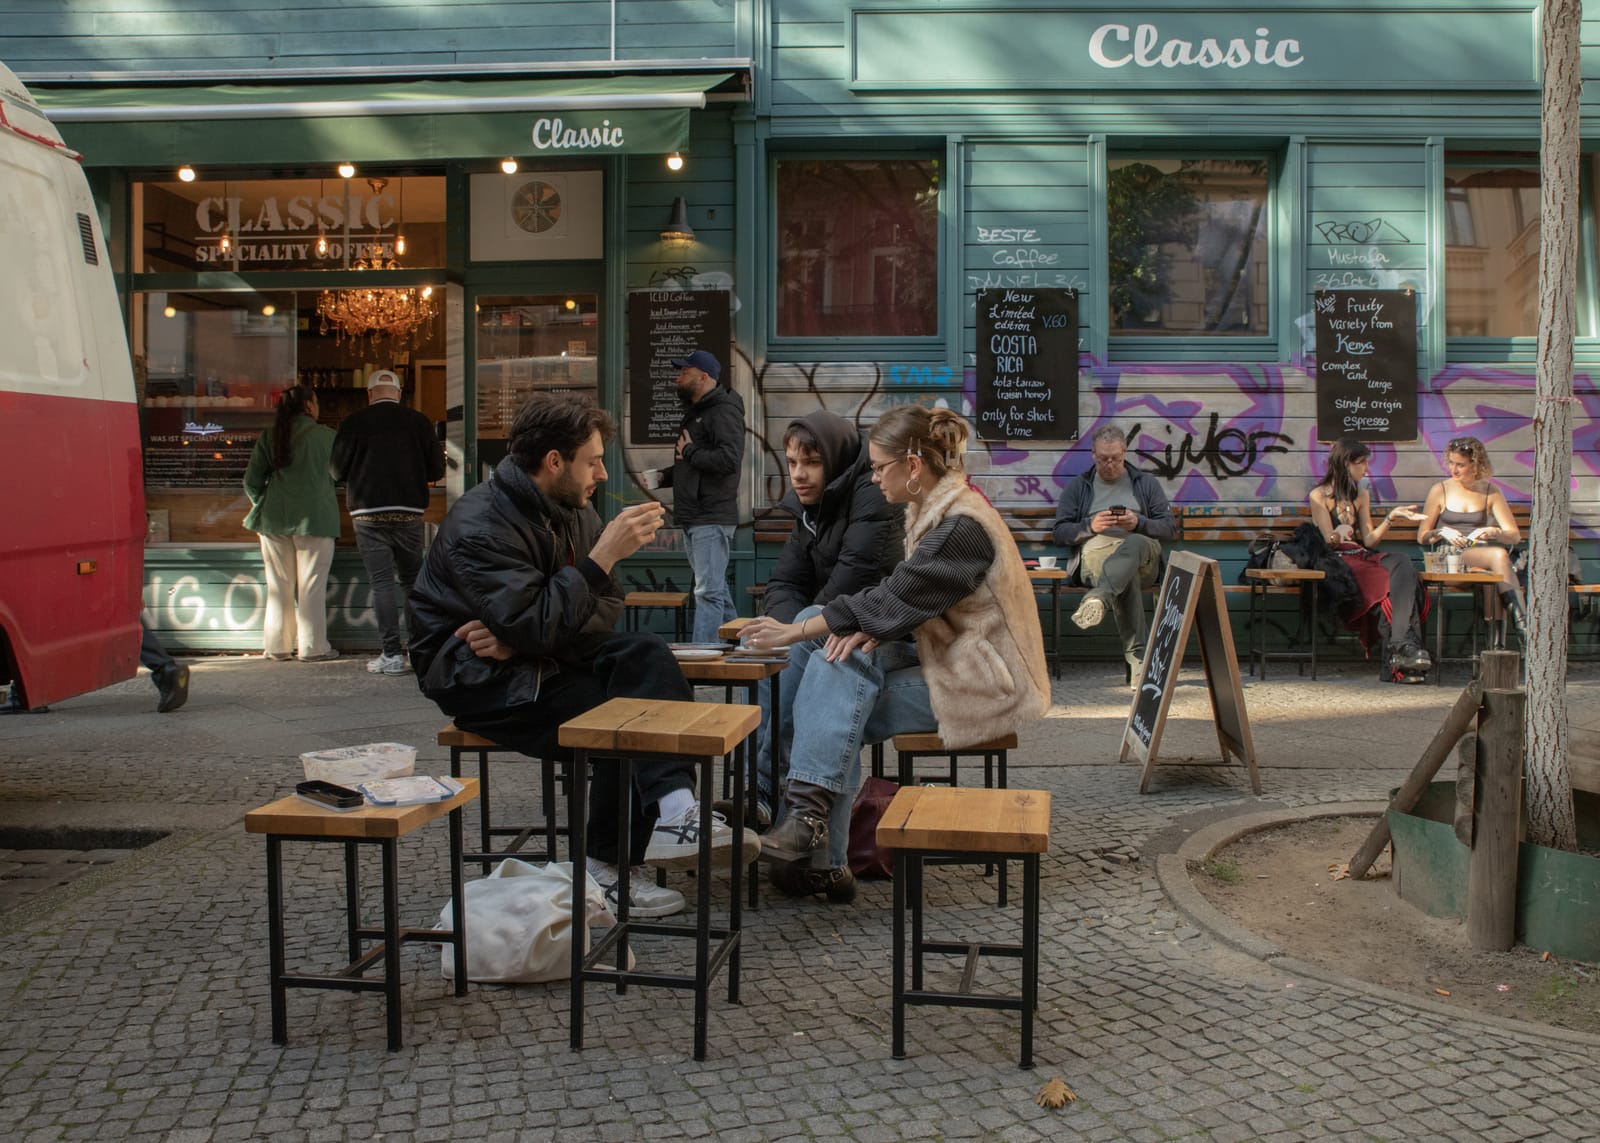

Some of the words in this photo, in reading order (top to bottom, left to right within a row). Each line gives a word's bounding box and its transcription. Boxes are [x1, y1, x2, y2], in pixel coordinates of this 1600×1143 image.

[1088, 24, 1304, 68] Classic
[532, 118, 624, 149] Classic
[196, 196, 395, 233] CLASSIC
[977, 226, 1041, 242] BESTE
[195, 243, 310, 262] SPECIALTY
[992, 249, 1059, 268] Coffee
[650, 293, 669, 303] ICED
[1002, 290, 1034, 303] New
[1315, 294, 1336, 312] New
[989, 304, 1035, 320] Limited
[994, 320, 1031, 332] edition
[990, 334, 1038, 355] COSTA
[1335, 333, 1376, 355] Kenya
[996, 356, 1024, 373] RICA
[1347, 370, 1368, 380] and
[1370, 398, 1403, 413] origin
[982, 408, 1007, 428] only
[1343, 416, 1390, 431] espresso
[1006, 423, 1032, 437] time
